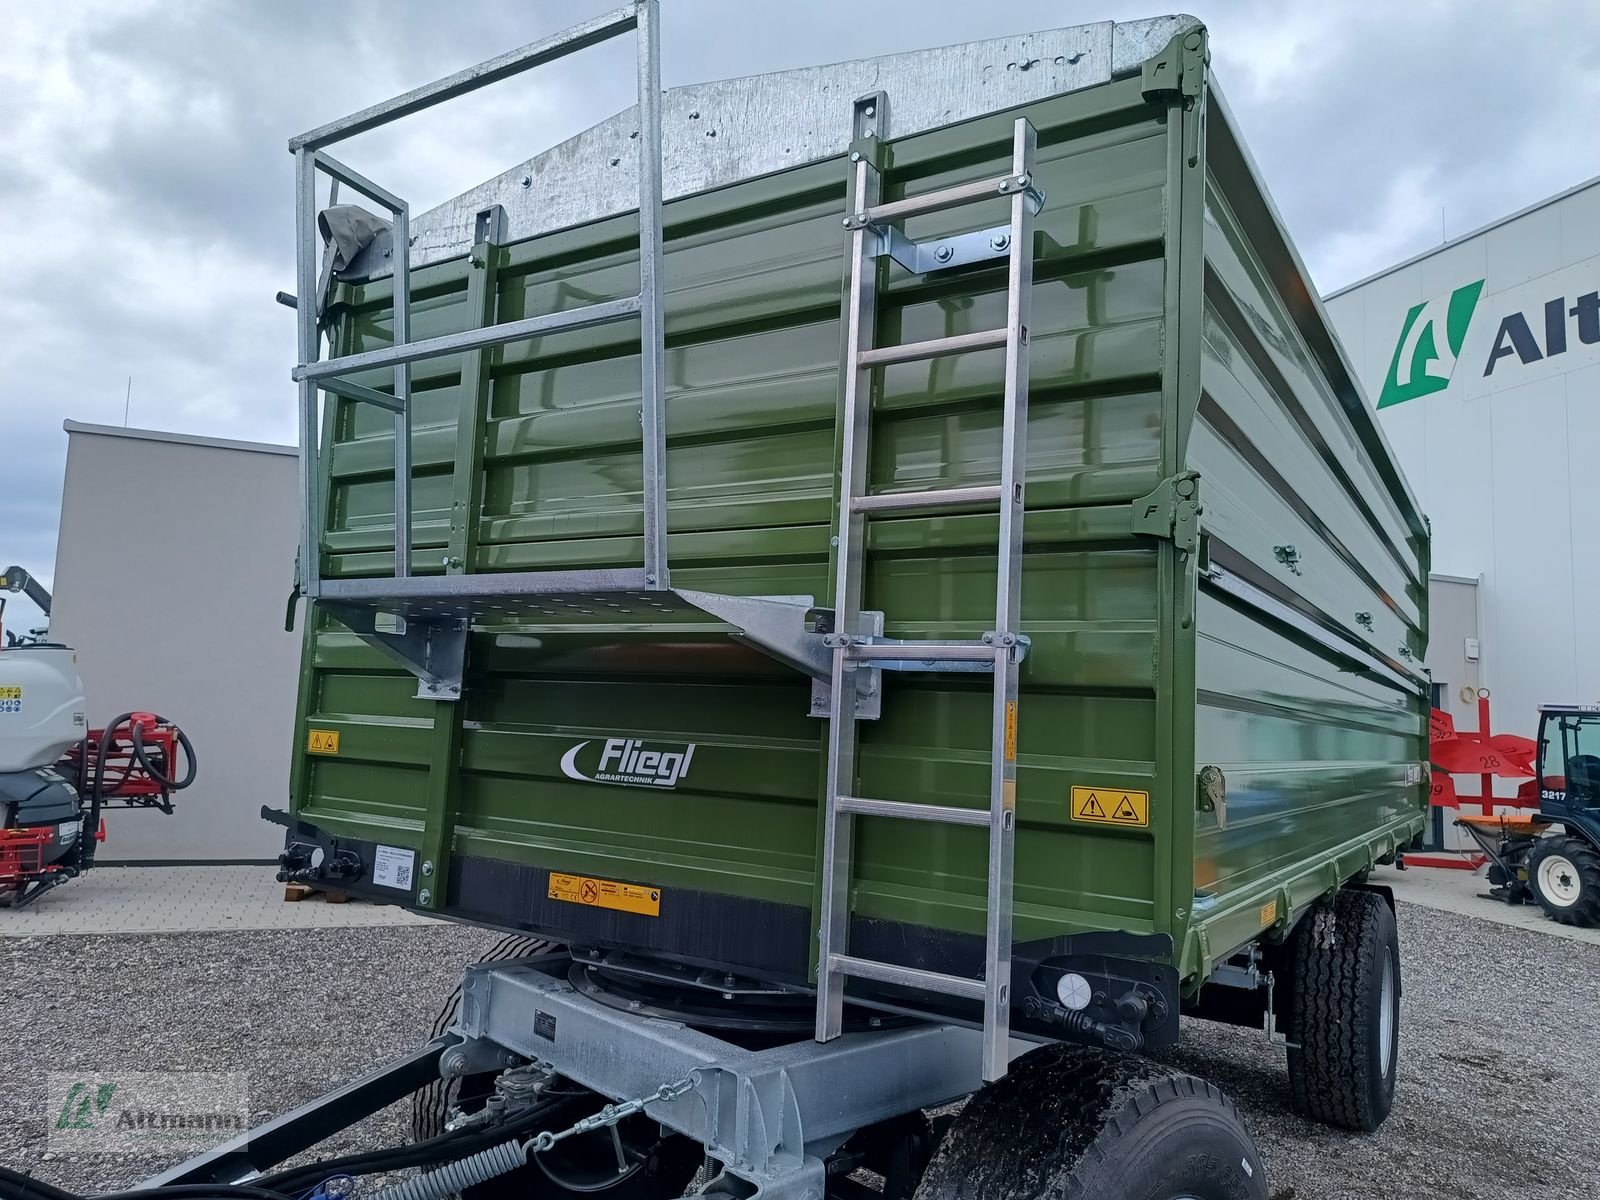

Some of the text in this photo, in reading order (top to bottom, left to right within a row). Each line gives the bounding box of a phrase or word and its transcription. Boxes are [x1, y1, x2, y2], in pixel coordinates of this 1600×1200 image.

[1482, 290, 1600, 378] Alt
[1143, 504, 1159, 519] F
[598, 738, 696, 786] Fliegl
[1480, 755, 1500, 769] 28
[595, 773, 653, 784] AGRARTECHNIK
[1541, 790, 1567, 801] 3217
